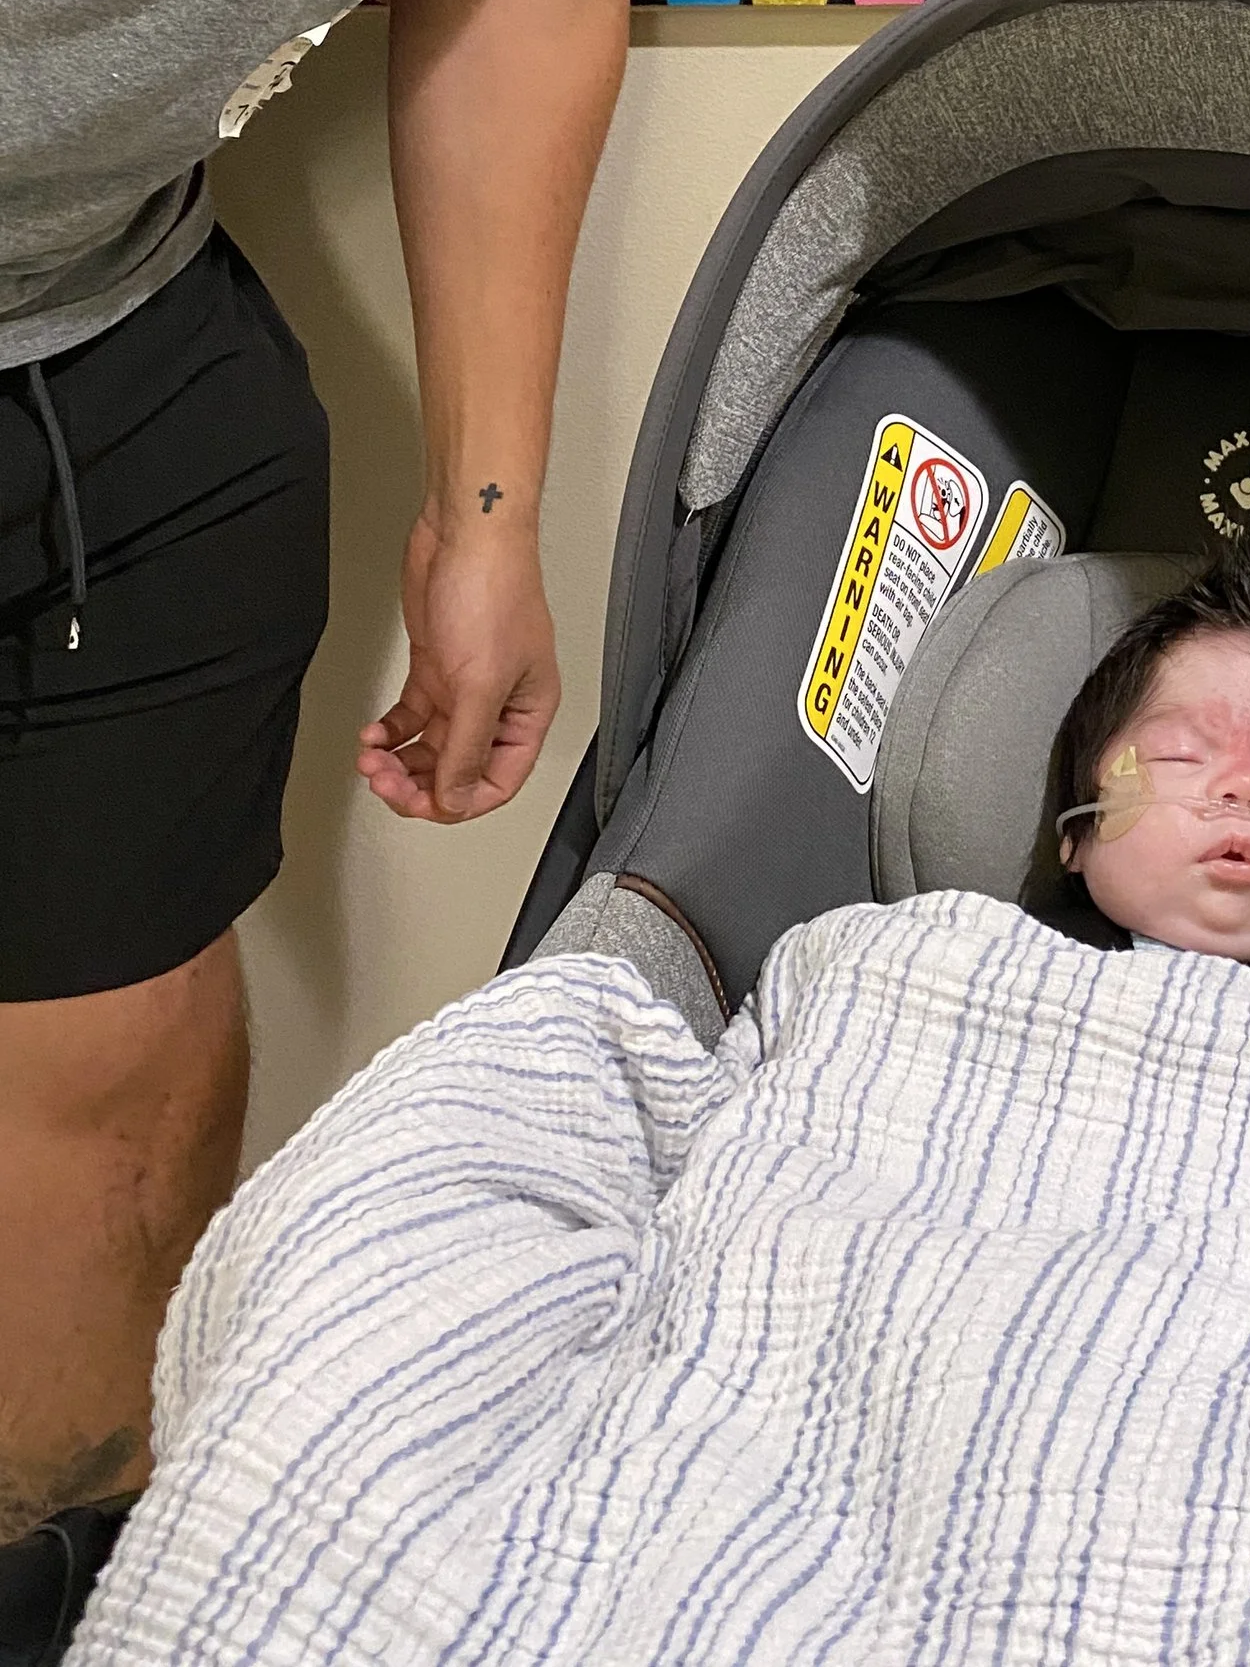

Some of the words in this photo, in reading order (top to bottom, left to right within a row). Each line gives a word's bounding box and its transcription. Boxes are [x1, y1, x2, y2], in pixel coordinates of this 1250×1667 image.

[888, 551, 925, 595] rear-facing
[922, 587, 937, 609] child
[893, 534, 906, 552] DO
[905, 544, 921, 566] NOT
[919, 561, 936, 584] place
[814, 480, 896, 716] WARNING
[880, 582, 896, 604] with
[894, 597, 905, 613] air
[883, 567, 901, 588] seat
[899, 581, 909, 596] on
[907, 588, 922, 612] front
[918, 606, 931, 625] seat
[862, 638, 875, 657] can
[867, 619, 892, 656] SERIOUS
[889, 646, 905, 676] INJURY
[872, 603, 894, 634] DEATH
[891, 625, 901, 644] OR
[848, 676, 859, 697] the
[857, 690, 874, 716] safest
[870, 709, 883, 732] place
[854, 659, 866, 681] The
[864, 672, 877, 697] back
[876, 691, 887, 711] seat
[836, 712, 851, 731] and
[847, 725, 863, 750] under.
[842, 693, 853, 711] for
[851, 705, 871, 738] children
[868, 728, 877, 745] 12
